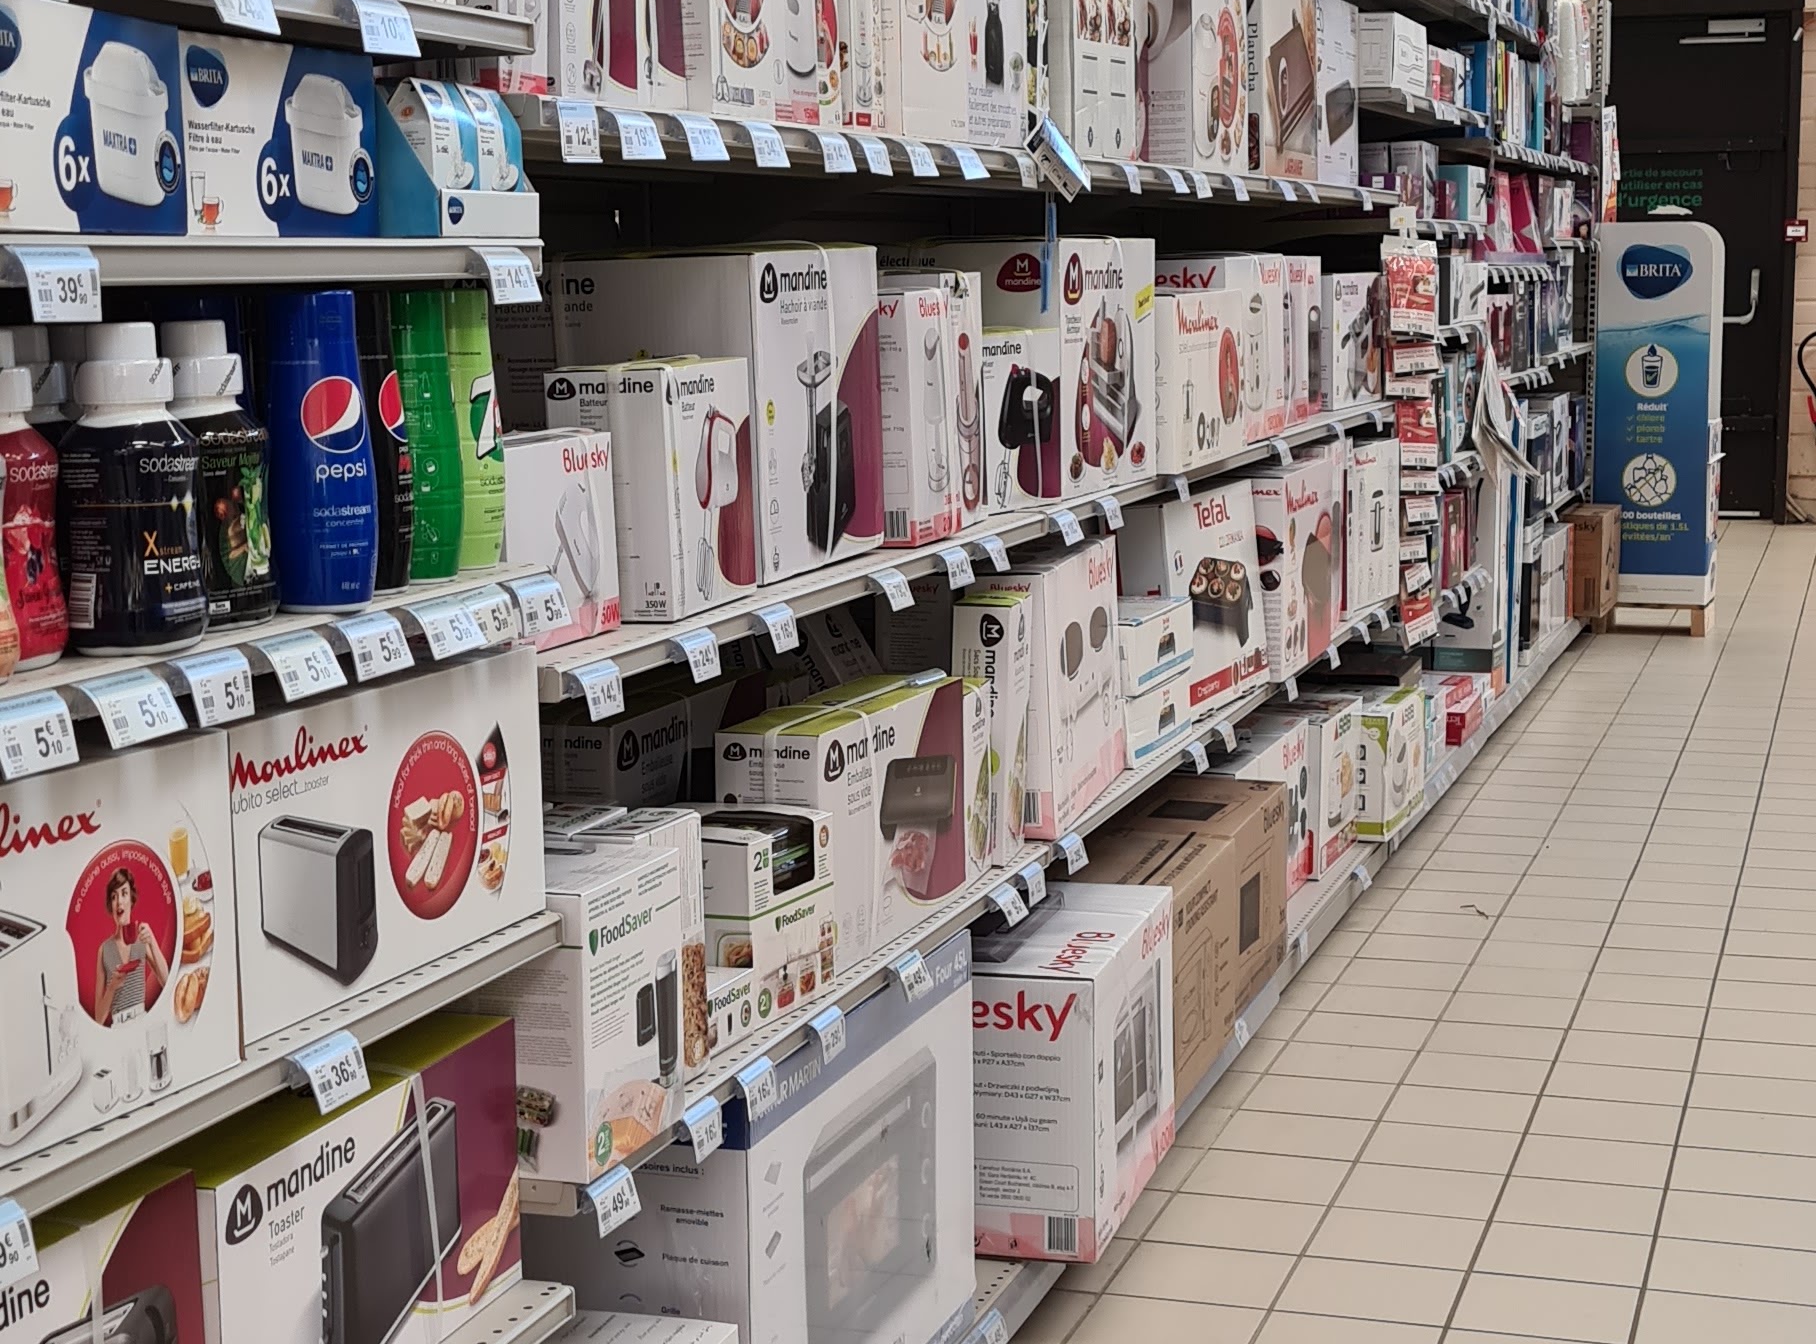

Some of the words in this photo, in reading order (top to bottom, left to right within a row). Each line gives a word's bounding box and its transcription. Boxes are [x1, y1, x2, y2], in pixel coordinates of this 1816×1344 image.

[0, 30, 16, 48] ITA
[1248, 22, 1258, 93] Plancha
[198, 66, 223, 85] BRITA
[0, 90, 51, 109] filter-Kartusche
[188, 119, 256, 135] Wasserfilter-Kartusche
[188, 131, 204, 144] Filtre
[211, 136, 222, 145] eau
[58, 136, 91, 191] 6x
[1622, 168, 1643, 177] rtie
[1661, 169, 1703, 177] secours
[261, 156, 291, 205] 6x
[1621, 180, 1663, 190] utiliser
[1665, 181, 1680, 190] en
[1682, 181, 1703, 190] cas
[779, 266, 827, 293] mandine
[1085, 262, 1124, 293] mandine
[1155, 265, 1217, 289] esky
[1639, 264, 1682, 277] BRITA
[1004, 277, 1041, 286] mandine
[1176, 299, 1218, 335] Moulinex
[982, 341, 1022, 357] mandine
[579, 378, 654, 395] madine
[680, 374, 715, 397] mandine
[580, 398, 608, 407] Batteur
[1637, 402, 1667, 412] Réduit
[201, 456, 236, 470] Saveur
[562, 439, 610, 474] Blusky
[316, 459, 367, 483] pepsi
[313, 505, 372, 517] sodastream
[1193, 494, 1231, 530] Tefal
[1636, 511, 1681, 520] bouteilles
[1622, 522, 1654, 531] stiques
[1088, 547, 1115, 590] Bluesky
[543, 736, 602, 750] mndine
[749, 746, 810, 760] mndine
[229, 725, 368, 793] Moulinex
[0, 802, 102, 857] linex
[600, 905, 654, 948] FoodSaver
[781, 904, 816, 929] FoodSaver
[934, 962, 953, 986] Four
[713, 980, 751, 1013] FoodSaver
[972, 990, 1077, 1042] esky
[789, 1056, 822, 1095] MARTIN
[266, 1136, 356, 1212] mandine
[672, 1164, 699, 1175] inclus
[660, 1204, 724, 1218] Ramasse-miettes
[675, 1216, 709, 1227] amovible
[268, 1205, 305, 1239] Toaster
[662, 1252, 686, 1266] Plaque
[687, 1255, 698, 1264] de
[699, 1257, 730, 1268] cuisson
[0, 1279, 50, 1329] dine
